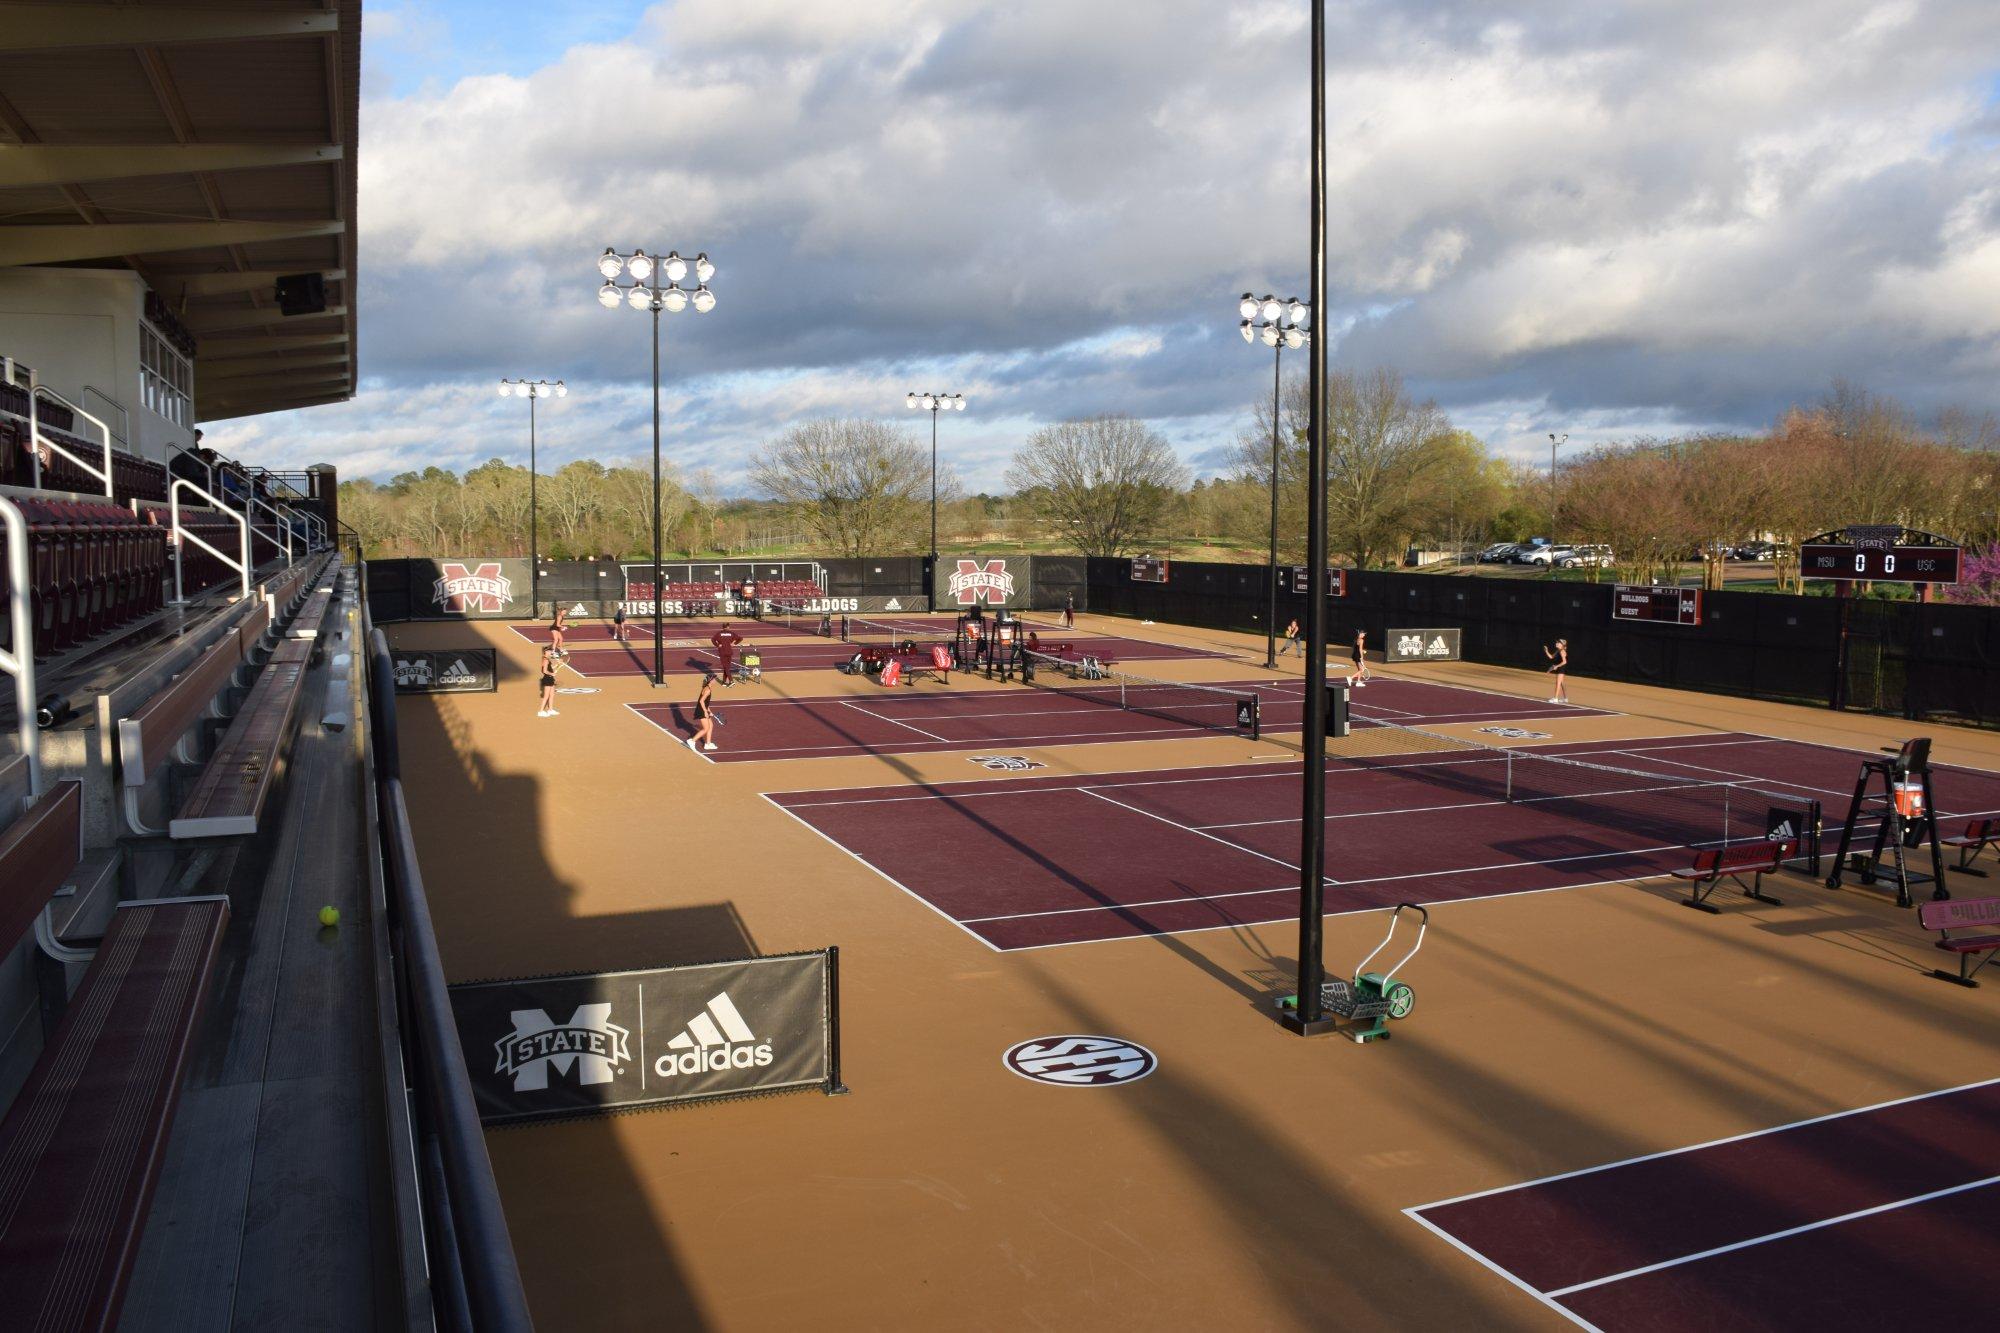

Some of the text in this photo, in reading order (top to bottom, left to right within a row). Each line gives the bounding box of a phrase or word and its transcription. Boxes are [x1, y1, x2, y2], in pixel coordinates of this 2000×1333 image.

[1860, 539, 1884, 549] STATE
[1818, 554, 1936, 573] MSU 0 0 USC
[448, 579, 497, 594] STATE
[961, 575, 1002, 587] STATE
[440, 674, 476, 684] adidas
[518, 1030, 606, 1061] STATE
[654, 1041, 774, 1077] adidas
